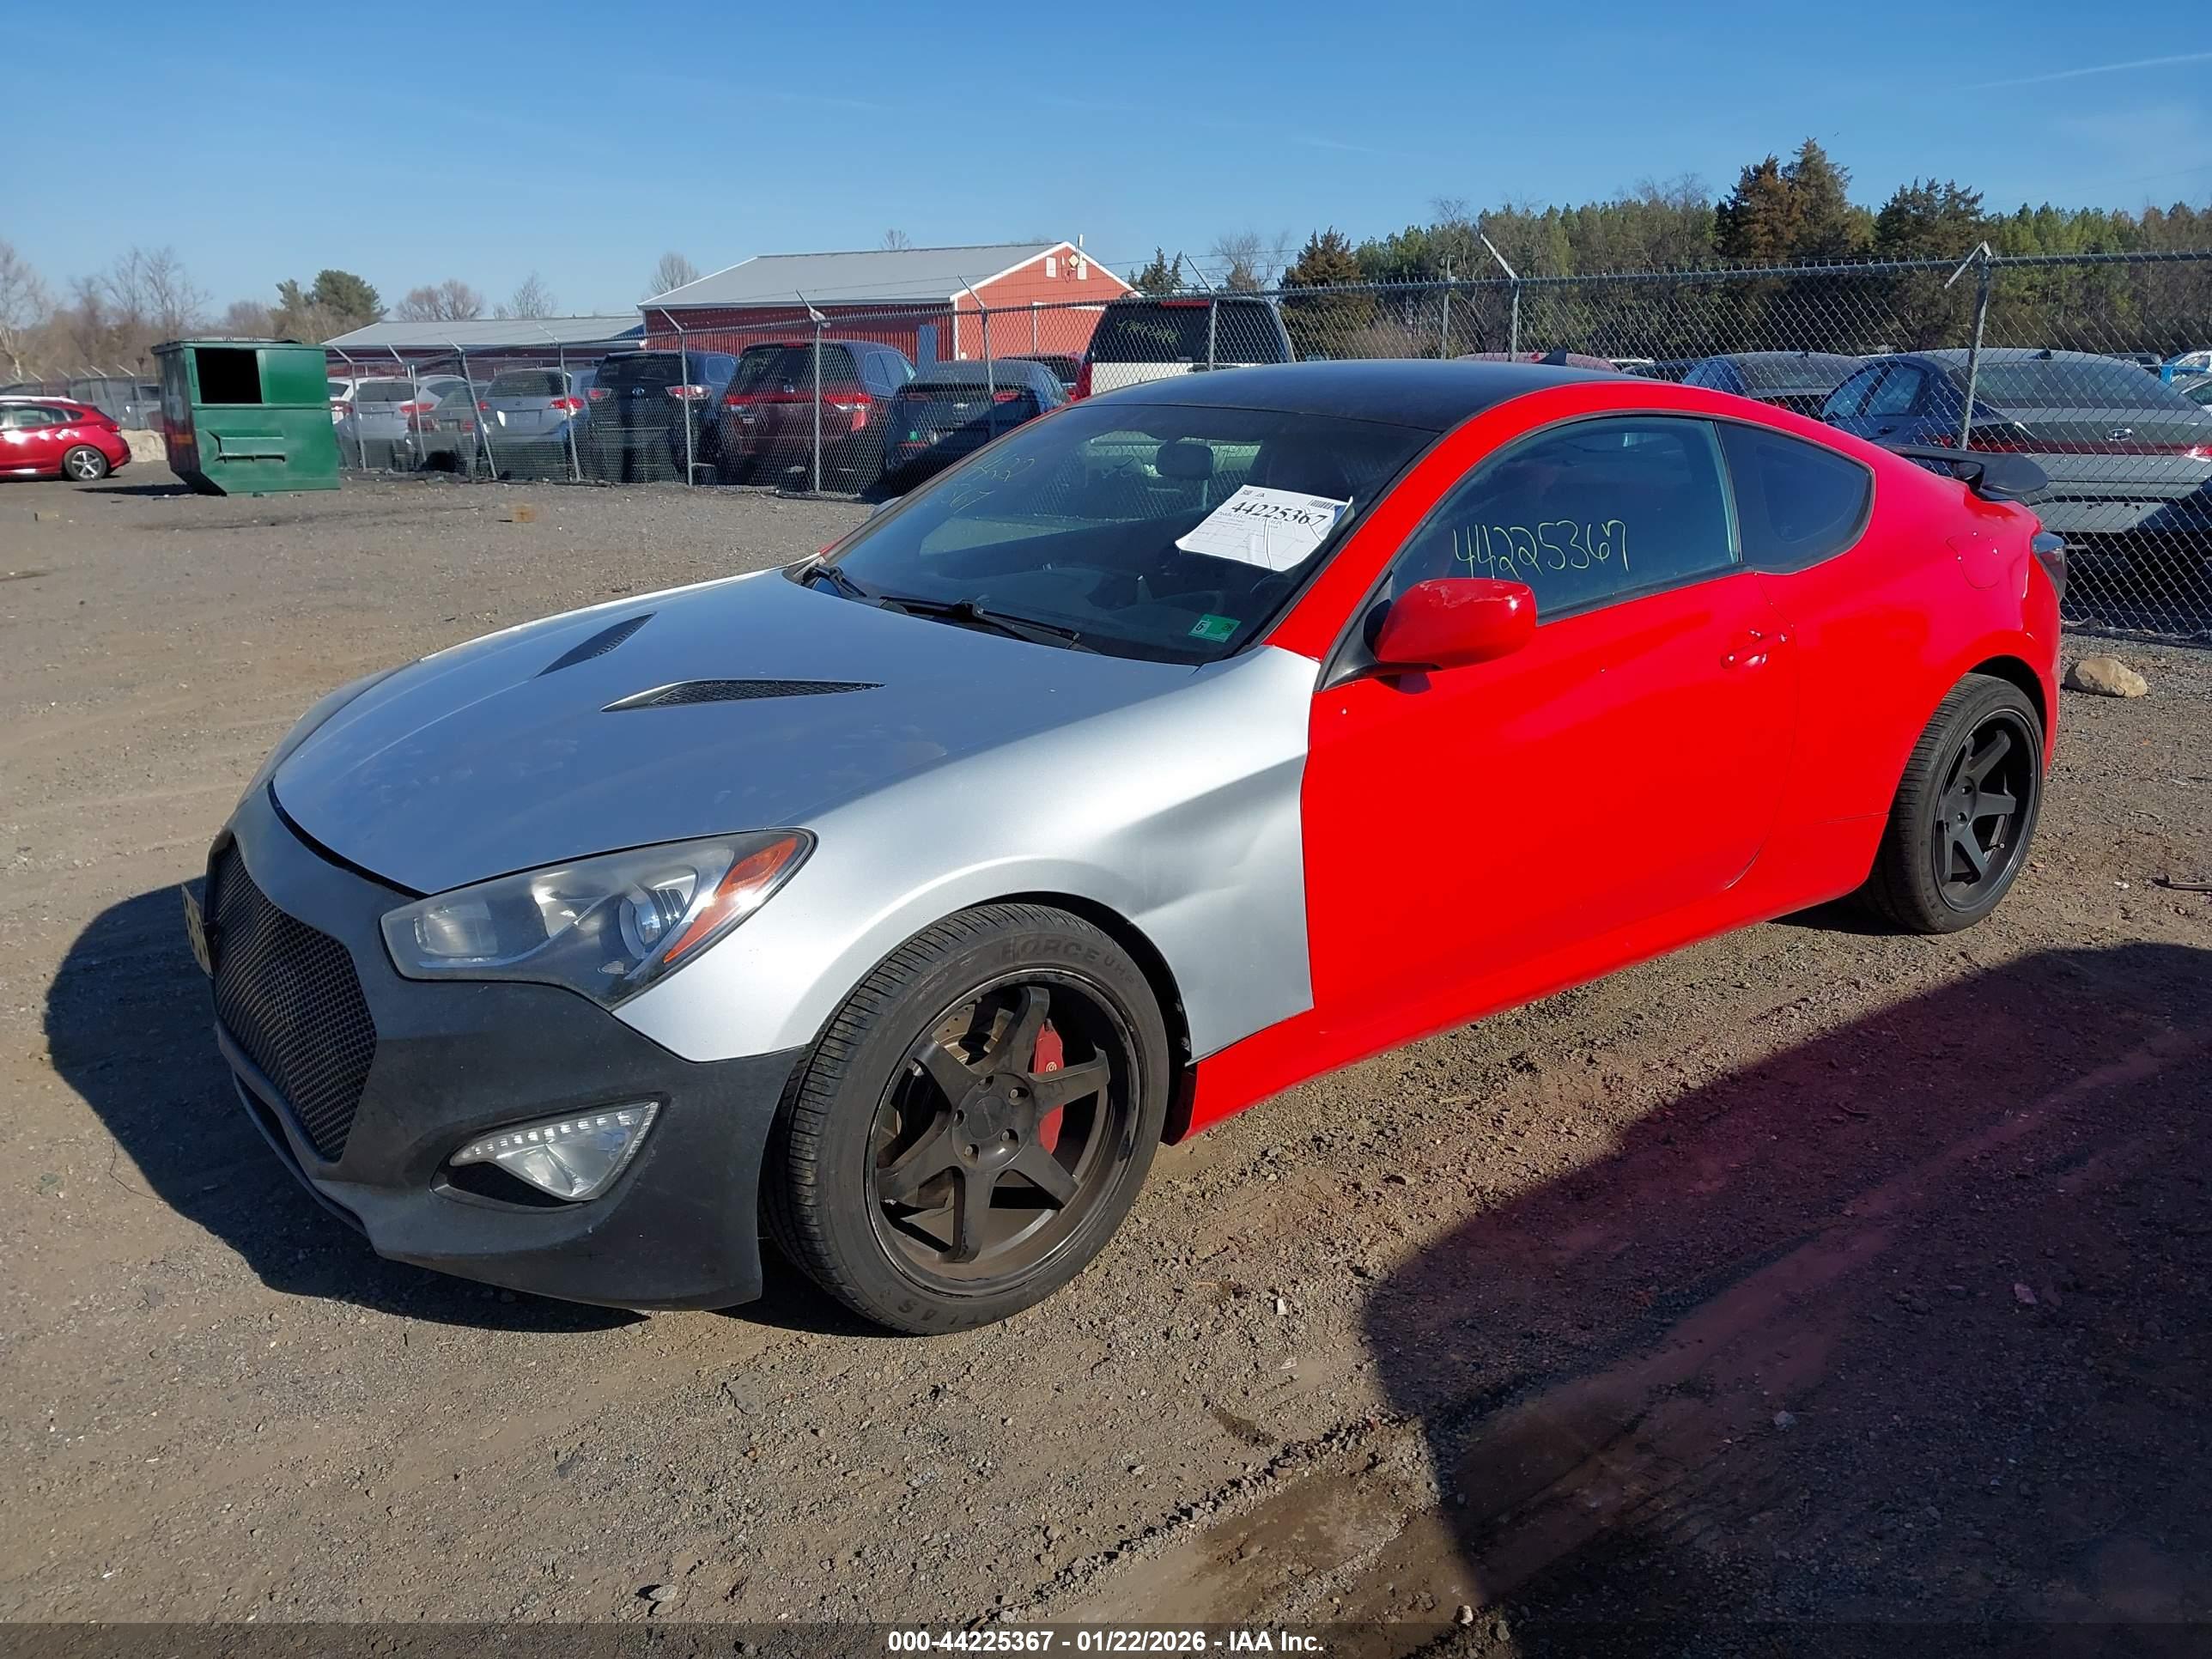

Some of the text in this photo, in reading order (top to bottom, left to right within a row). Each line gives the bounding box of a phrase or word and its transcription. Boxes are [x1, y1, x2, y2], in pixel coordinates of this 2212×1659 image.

[1231, 501, 1329, 526] 44225367
[1453, 520, 1630, 580] 44225367
[1001, 939, 1101, 963] FORCE
